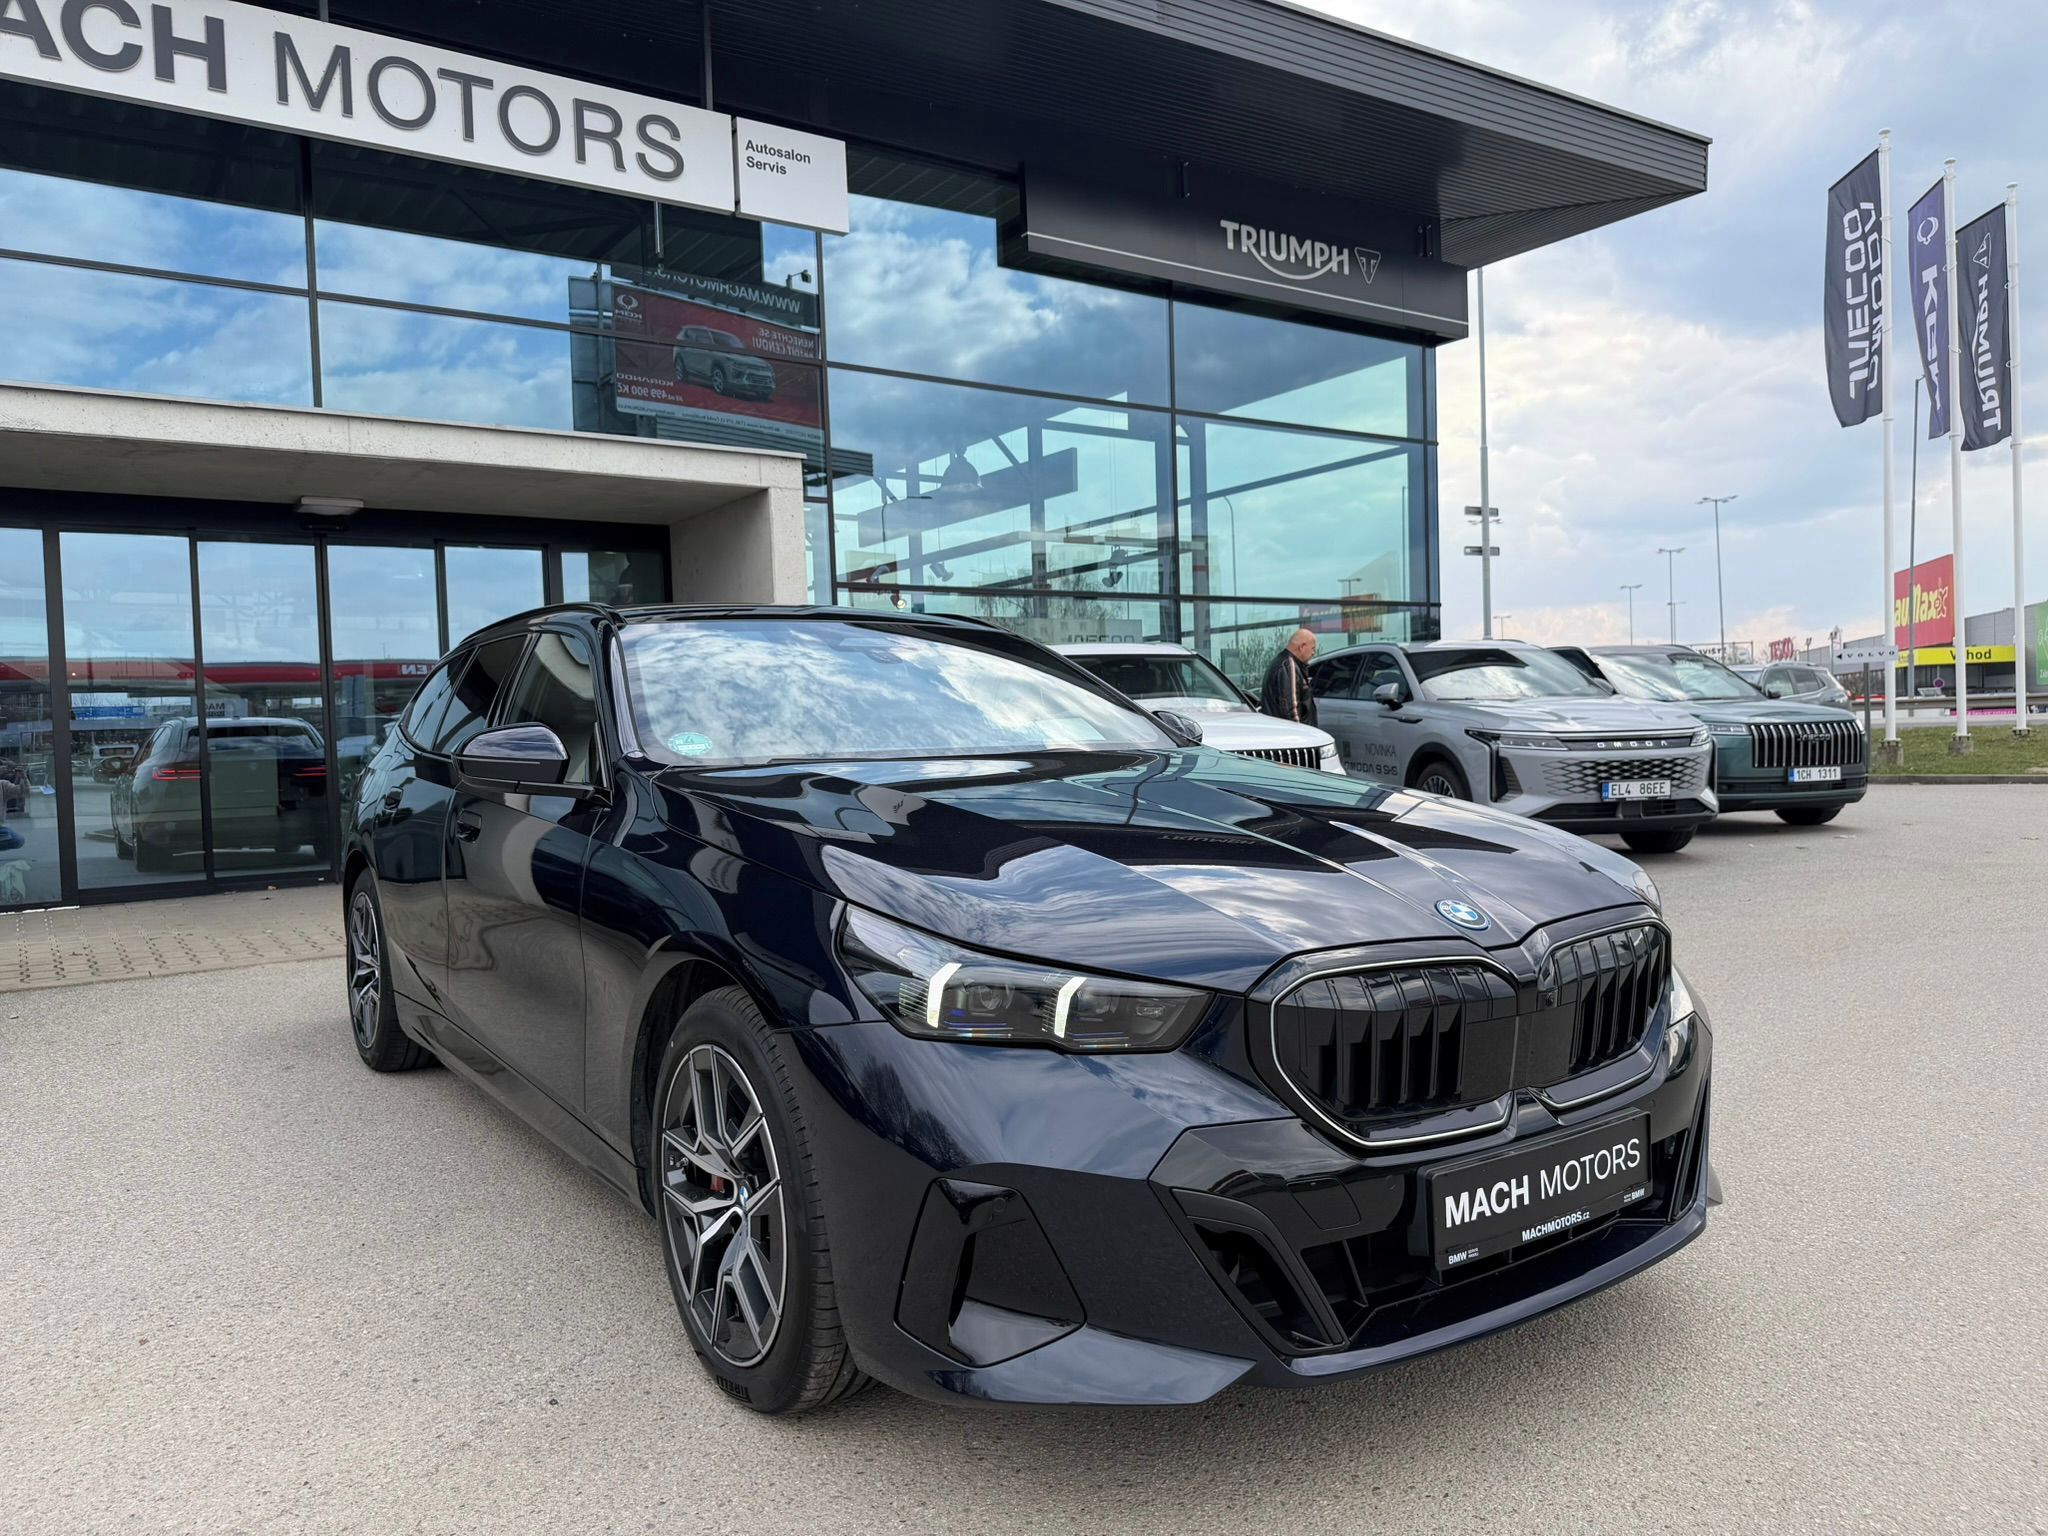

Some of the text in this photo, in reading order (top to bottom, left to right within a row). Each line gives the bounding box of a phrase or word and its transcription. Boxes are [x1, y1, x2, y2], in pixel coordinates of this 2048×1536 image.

[0, 0, 685, 181] ACH MOTORS
[745, 139, 811, 164] Autosalon
[746, 156, 787, 175] Servis
[1220, 219, 1350, 280] TRIUMPH
[1846, 650, 1895, 658] VOLVO
[1950, 648, 1992, 661] Vhod
[1796, 768, 1837, 780] 1CH 1311
[1611, 782, 1666, 796] EL4 86EE
[1445, 1138, 1641, 1228] MACH MOTORS
[1631, 1188, 1645, 1200] BMW
[1522, 1211, 1590, 1241] MACHMOTORS.cz
[1448, 1250, 1467, 1264] BMW
